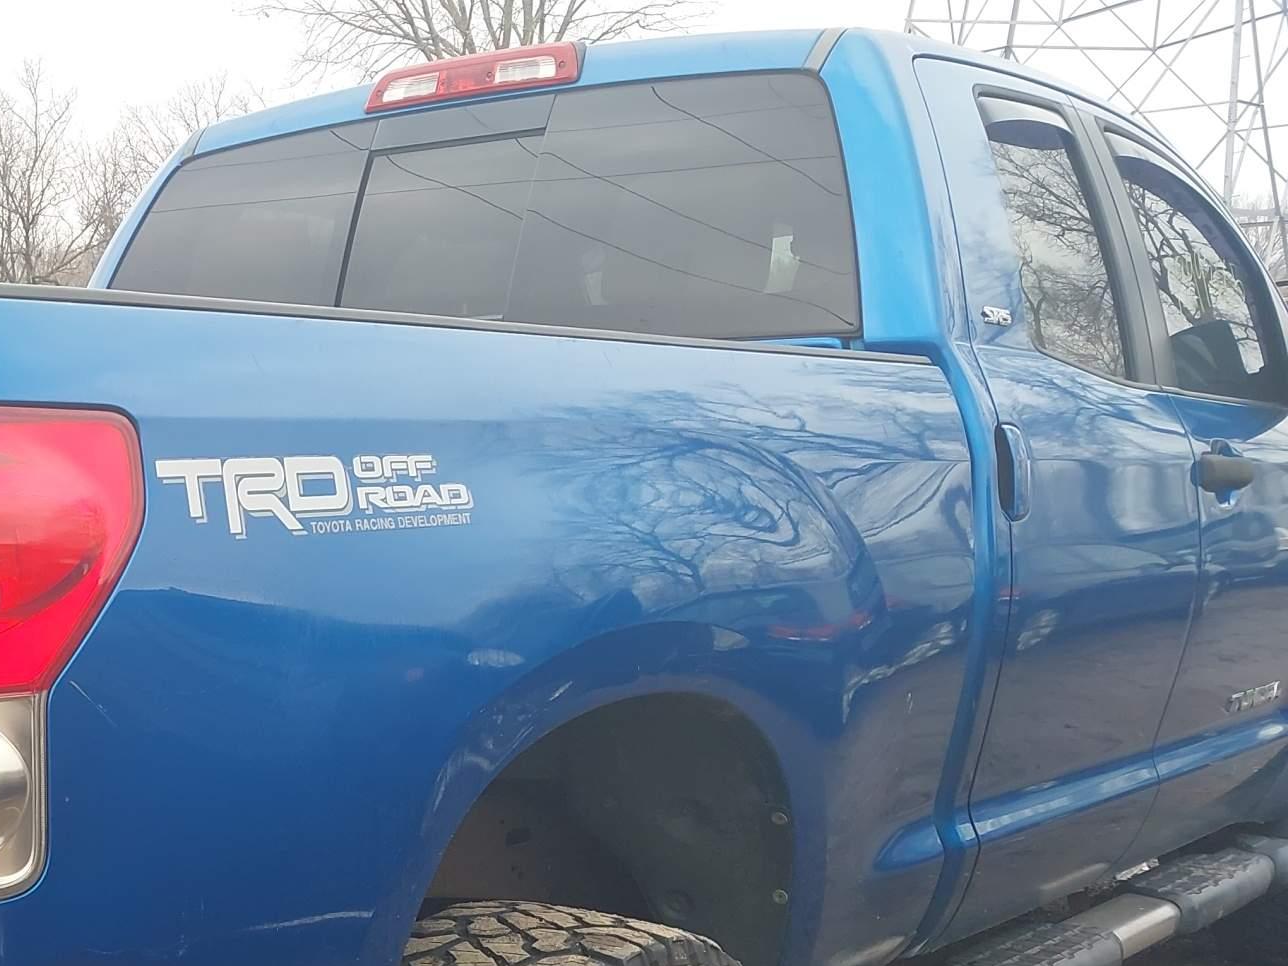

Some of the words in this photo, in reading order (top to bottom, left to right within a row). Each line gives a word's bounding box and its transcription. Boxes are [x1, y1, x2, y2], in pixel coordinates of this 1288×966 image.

[353, 454, 436, 482] OFF
[155, 455, 352, 538] TRD
[357, 482, 473, 513] ROAD
[310, 519, 353, 534] TOYOTA
[355, 516, 396, 532] RACING
[398, 512, 472, 529] DEVELOPMENT
